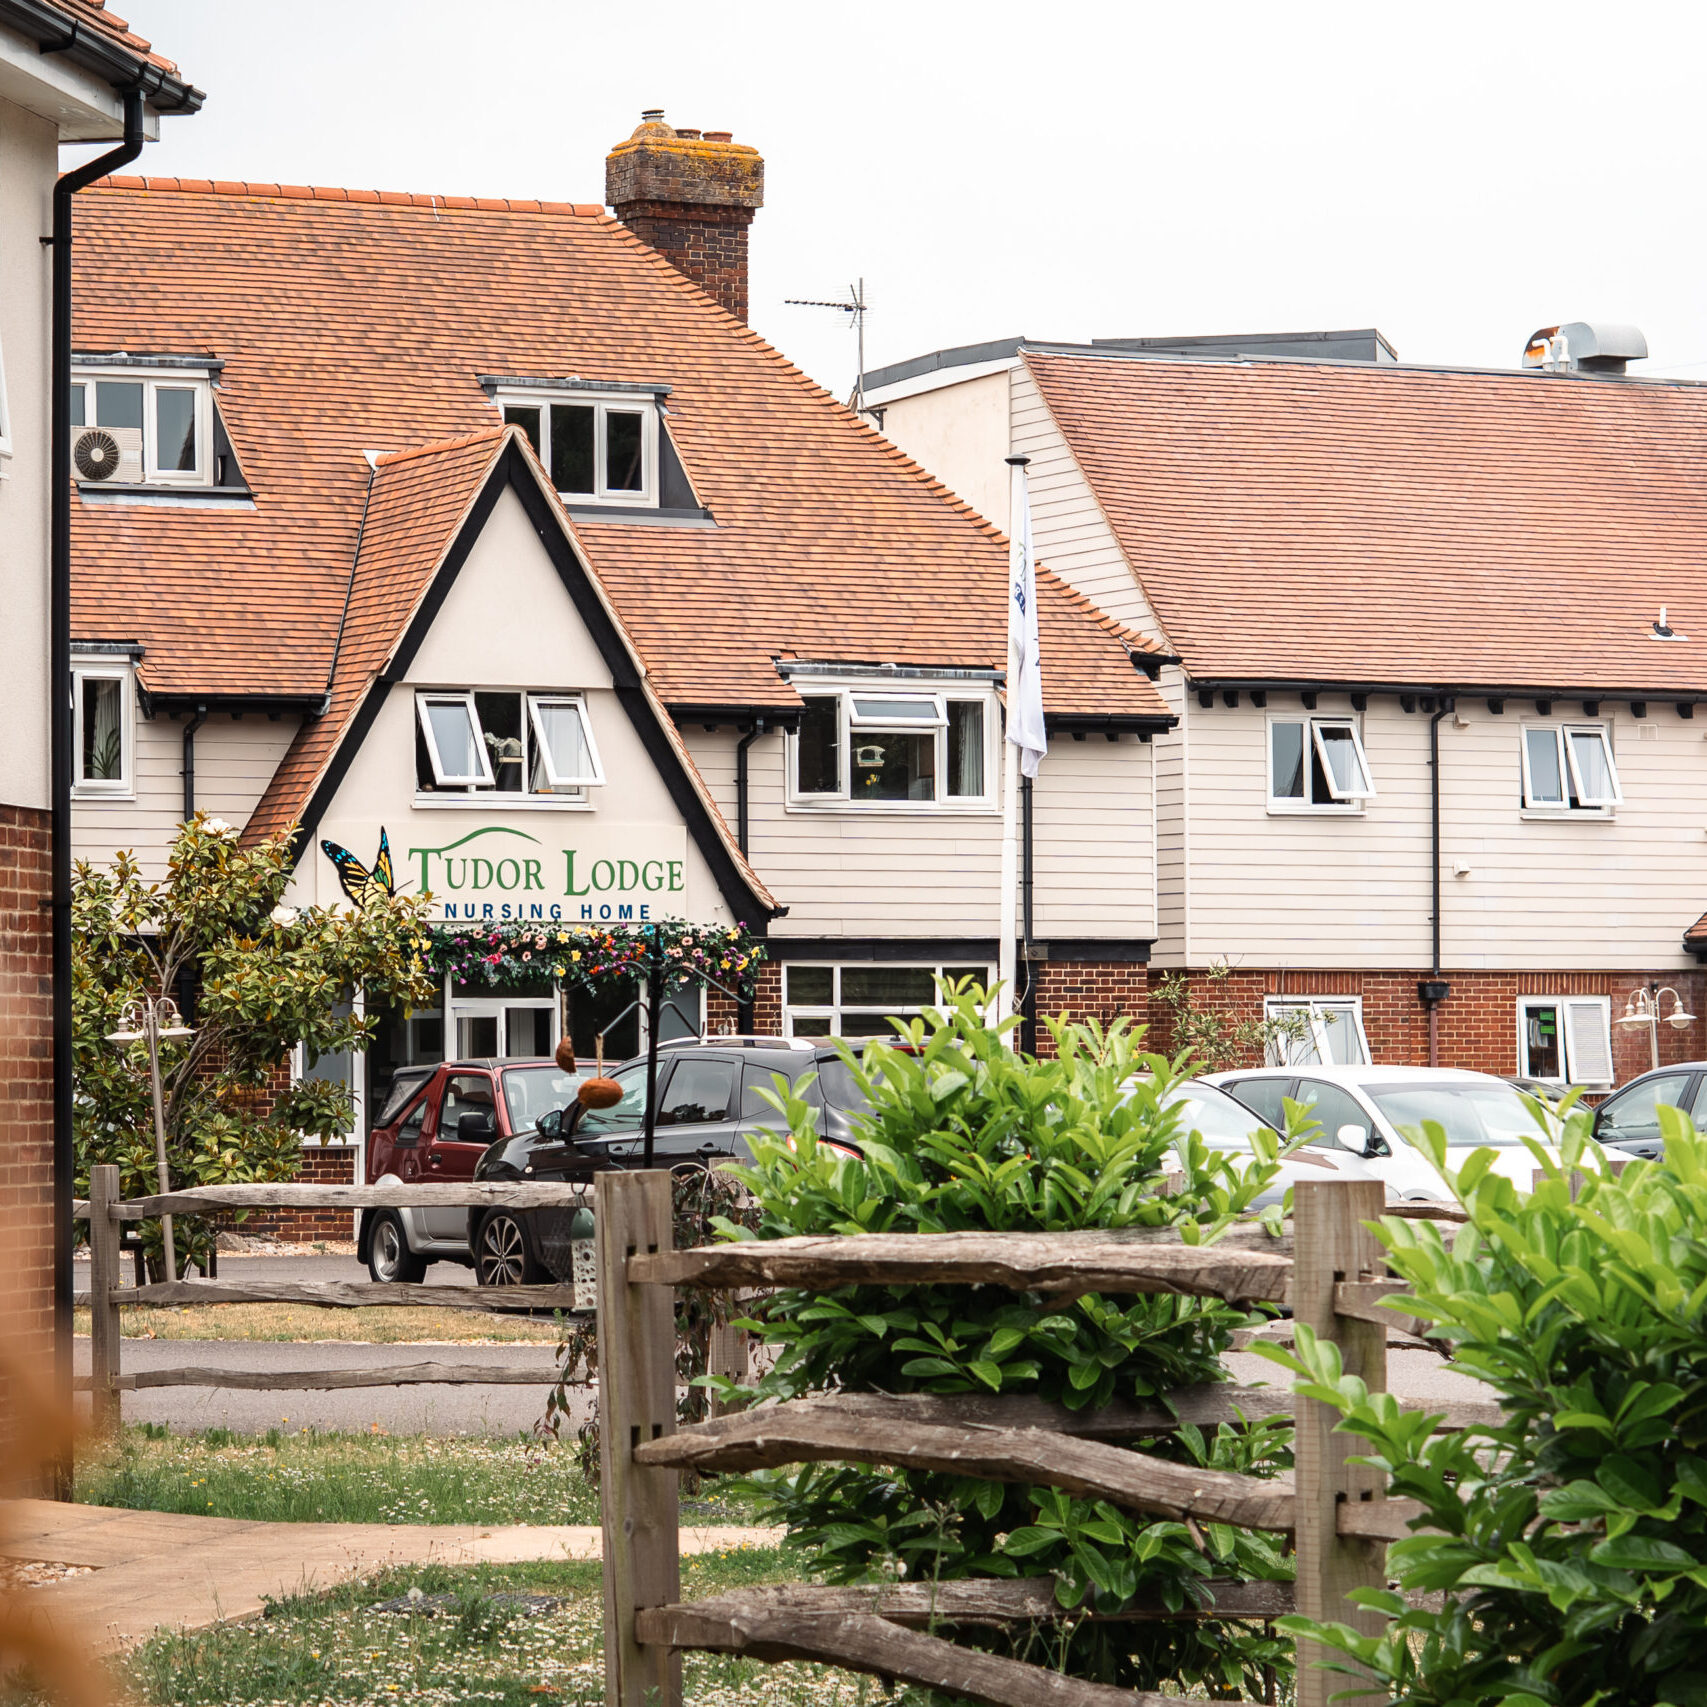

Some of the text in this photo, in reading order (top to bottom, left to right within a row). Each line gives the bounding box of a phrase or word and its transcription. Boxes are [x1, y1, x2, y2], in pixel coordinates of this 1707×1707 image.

[408, 847, 685, 896] TUDOR LODGE
[444, 903, 651, 920] NURSING HOME
